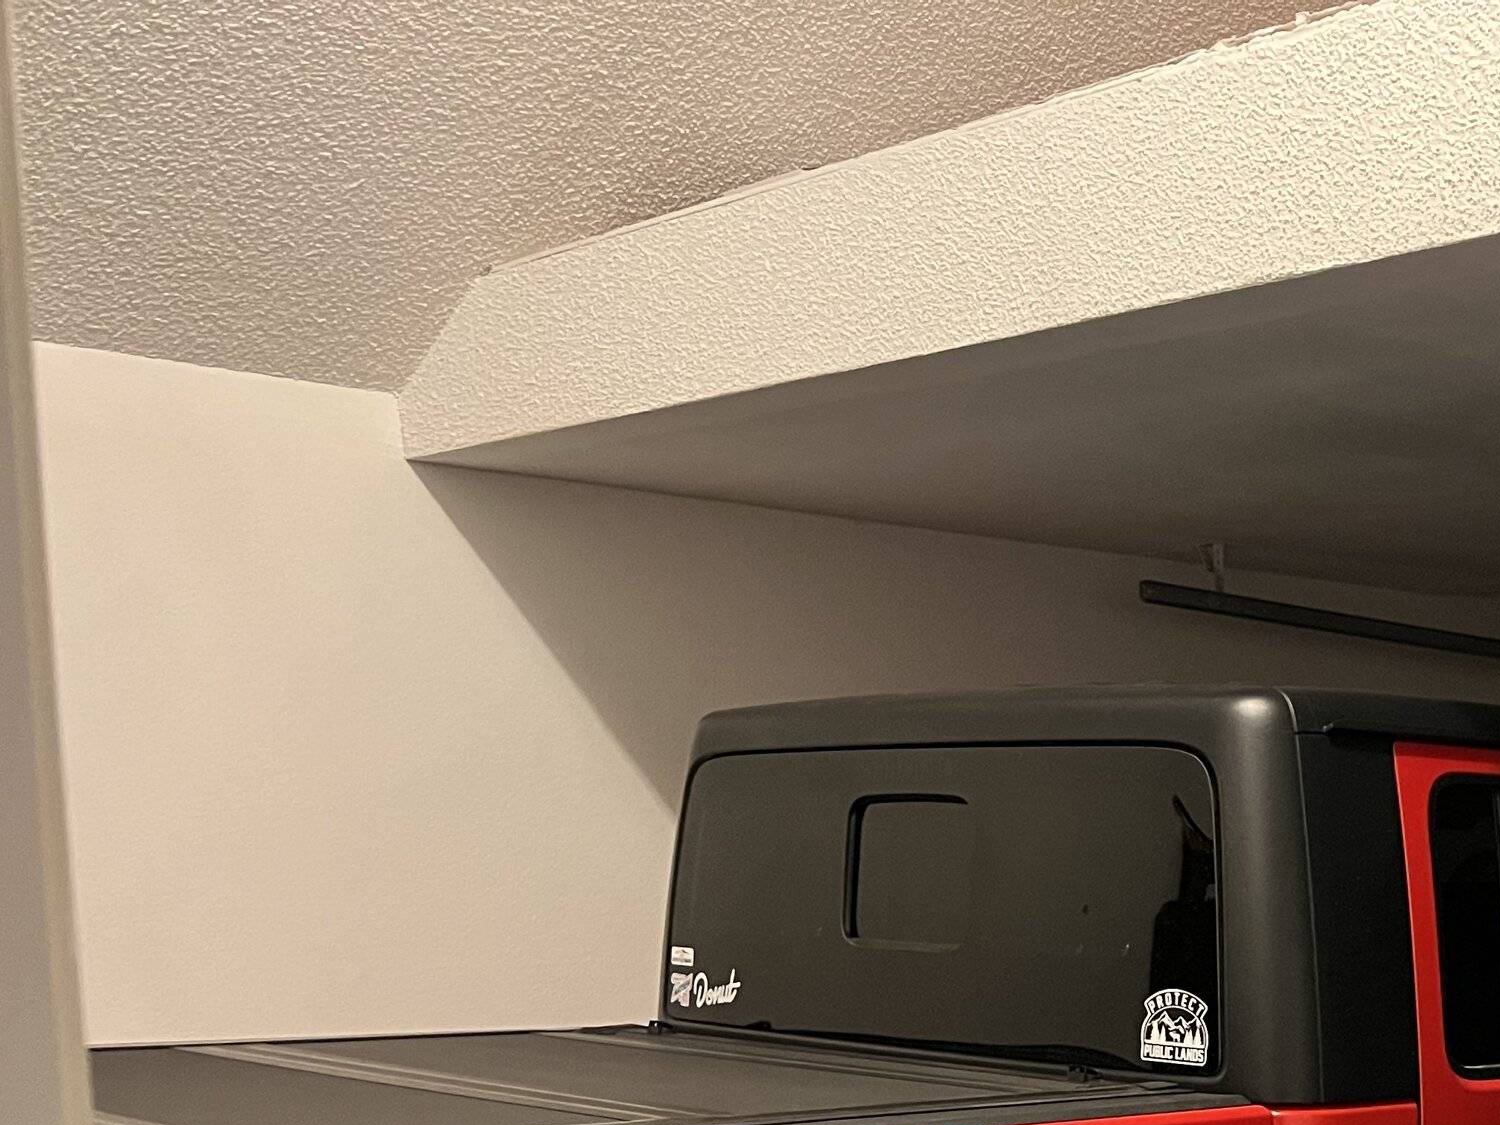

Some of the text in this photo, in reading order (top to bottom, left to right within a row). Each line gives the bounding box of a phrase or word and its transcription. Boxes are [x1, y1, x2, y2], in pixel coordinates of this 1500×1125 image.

[693, 968, 741, 1008] Donut
[1148, 993, 1204, 1016] PROTECT
[1144, 1045, 1204, 1062] PUBLIC LANDS
